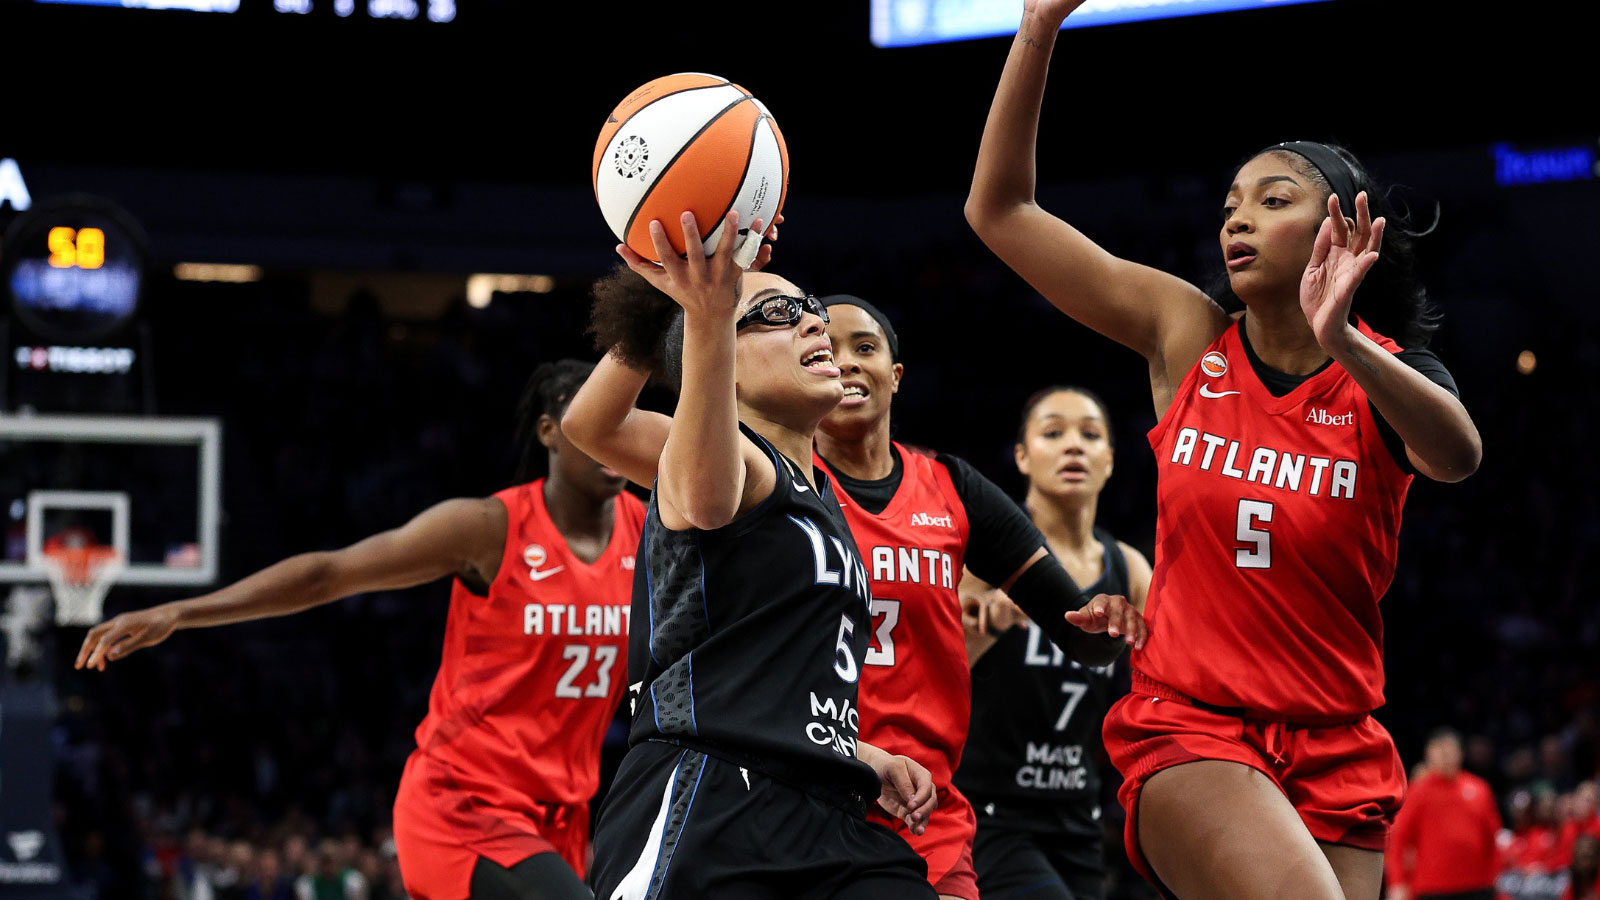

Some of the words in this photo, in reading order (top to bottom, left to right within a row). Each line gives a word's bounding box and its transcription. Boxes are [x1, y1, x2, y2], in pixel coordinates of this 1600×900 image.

[1305, 407, 1353, 426] Albert
[1171, 427, 1358, 499] ATLANTA
[911, 512, 952, 528] Albert
[1235, 499, 1273, 569] 5
[788, 514, 872, 616] LYN
[872, 546, 953, 590] ANTA
[523, 603, 631, 636] ATLANT
[864, 598, 900, 666] 3
[555, 644, 619, 699] 23
[833, 612, 860, 683] 5
[1055, 681, 1089, 731] 7
